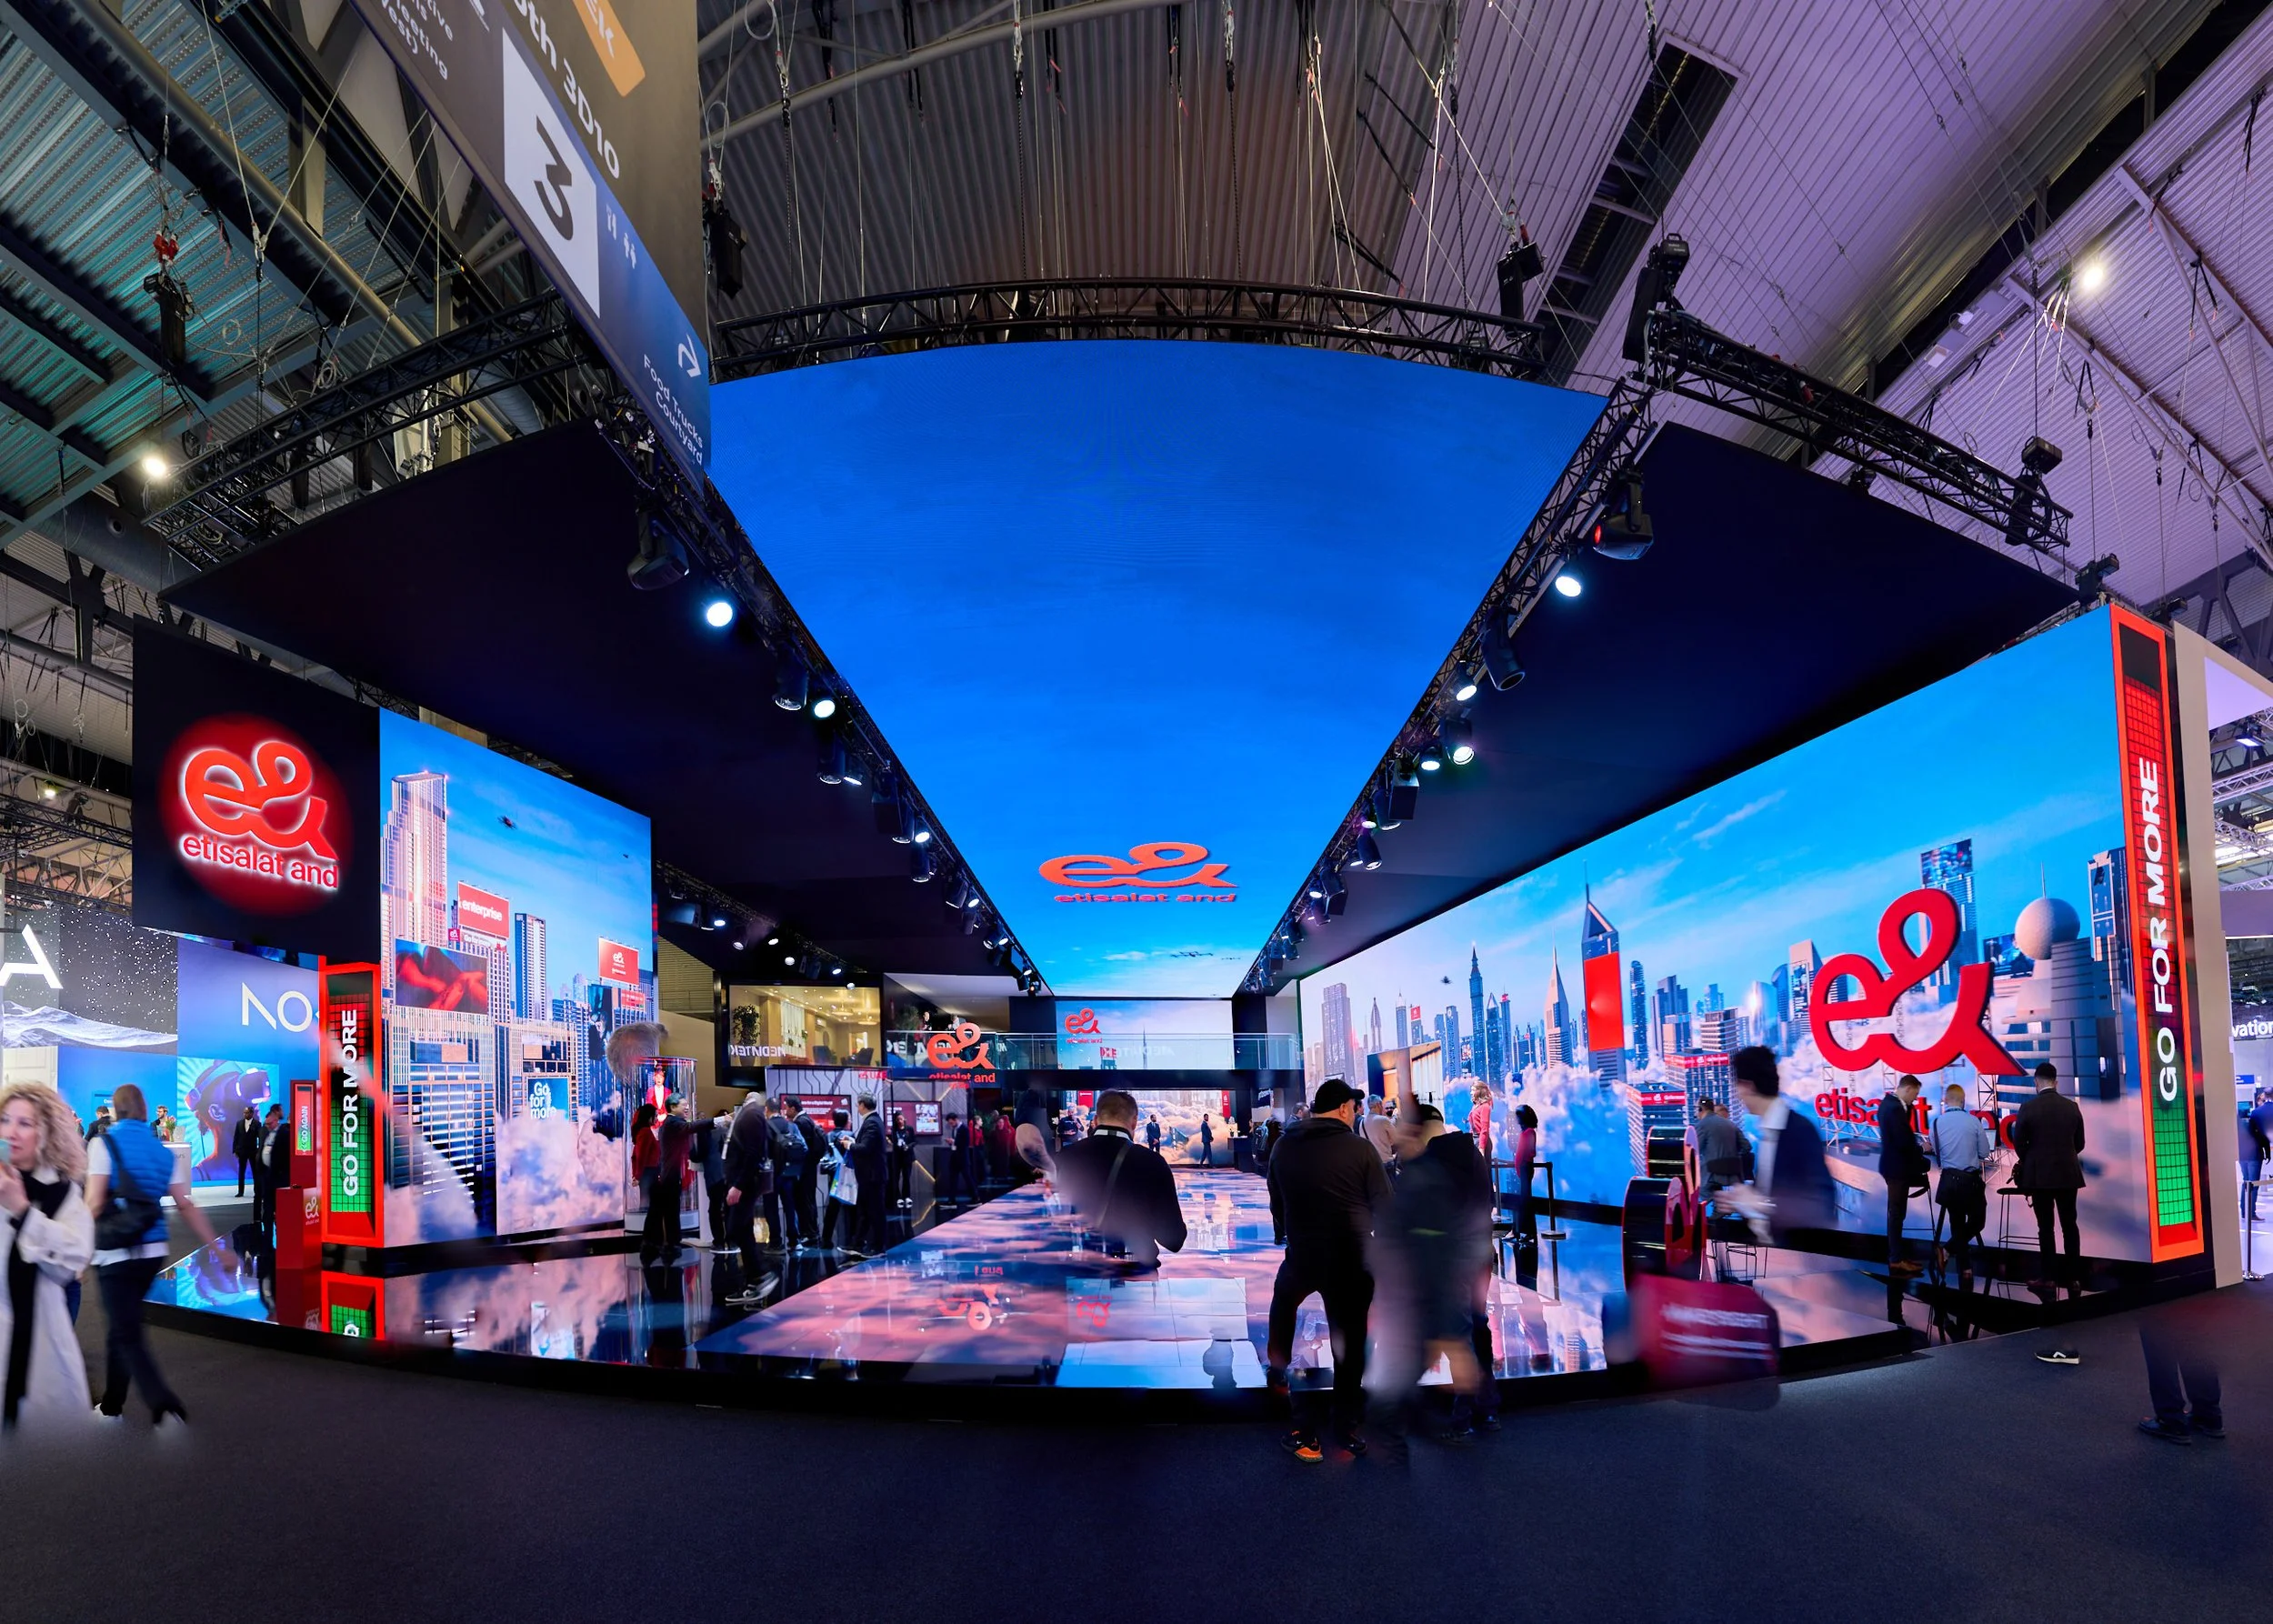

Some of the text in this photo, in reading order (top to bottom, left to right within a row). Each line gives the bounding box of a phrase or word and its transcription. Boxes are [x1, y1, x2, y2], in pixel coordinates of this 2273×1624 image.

[396, 0, 448, 80] eeting
[564, 57, 620, 179] 3D10
[534, 115, 575, 242] 3
[644, 354, 703, 448] Food Trucks
[656, 391, 703, 466] Courtyard
[182, 835, 339, 889] etisalat and
[462, 899, 503, 922] enterprise
[1054, 892, 1237, 903] etisalat and
[2138, 757, 2178, 1102] GO FOR MORE
[242, 982, 320, 1033] NO
[341, 1008, 359, 1197] GO FOR MORE
[529, 1093, 545, 1108] for
[534, 1081, 551, 1097] Go
[974, 1072, 996, 1083] and
[1815, 1087, 1933, 1136] etisat
